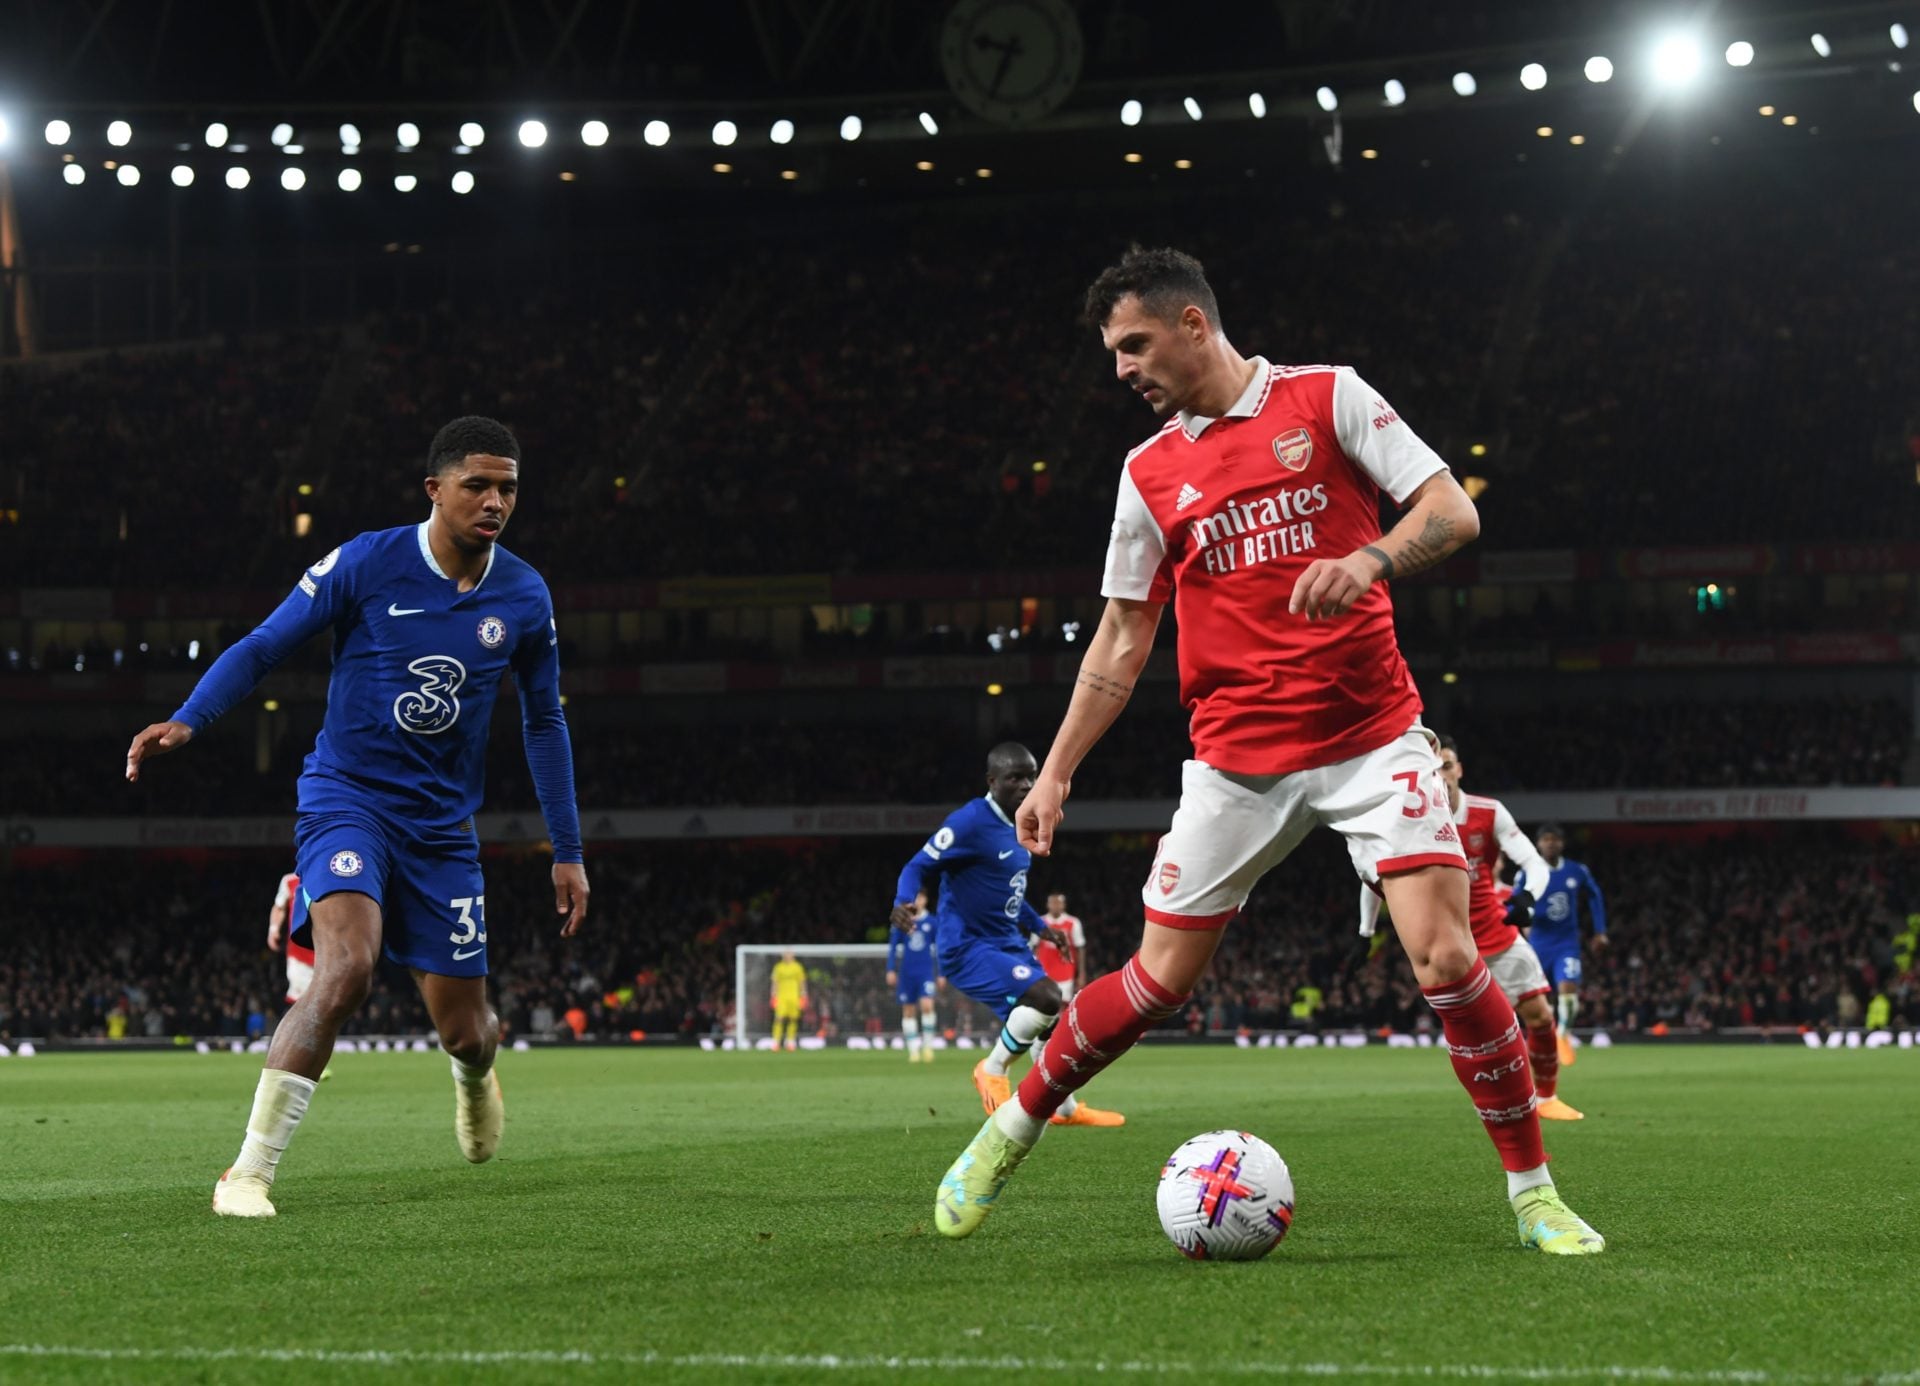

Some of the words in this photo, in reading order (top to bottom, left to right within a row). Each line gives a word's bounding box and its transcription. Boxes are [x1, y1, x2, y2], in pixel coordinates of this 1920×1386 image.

[1204, 541, 1236, 575] FLY
[1243, 521, 1317, 567] BETTER
[393, 655, 467, 735] 3
[1434, 833, 1458, 843] adid
[1473, 1055, 1525, 1082] AFC
